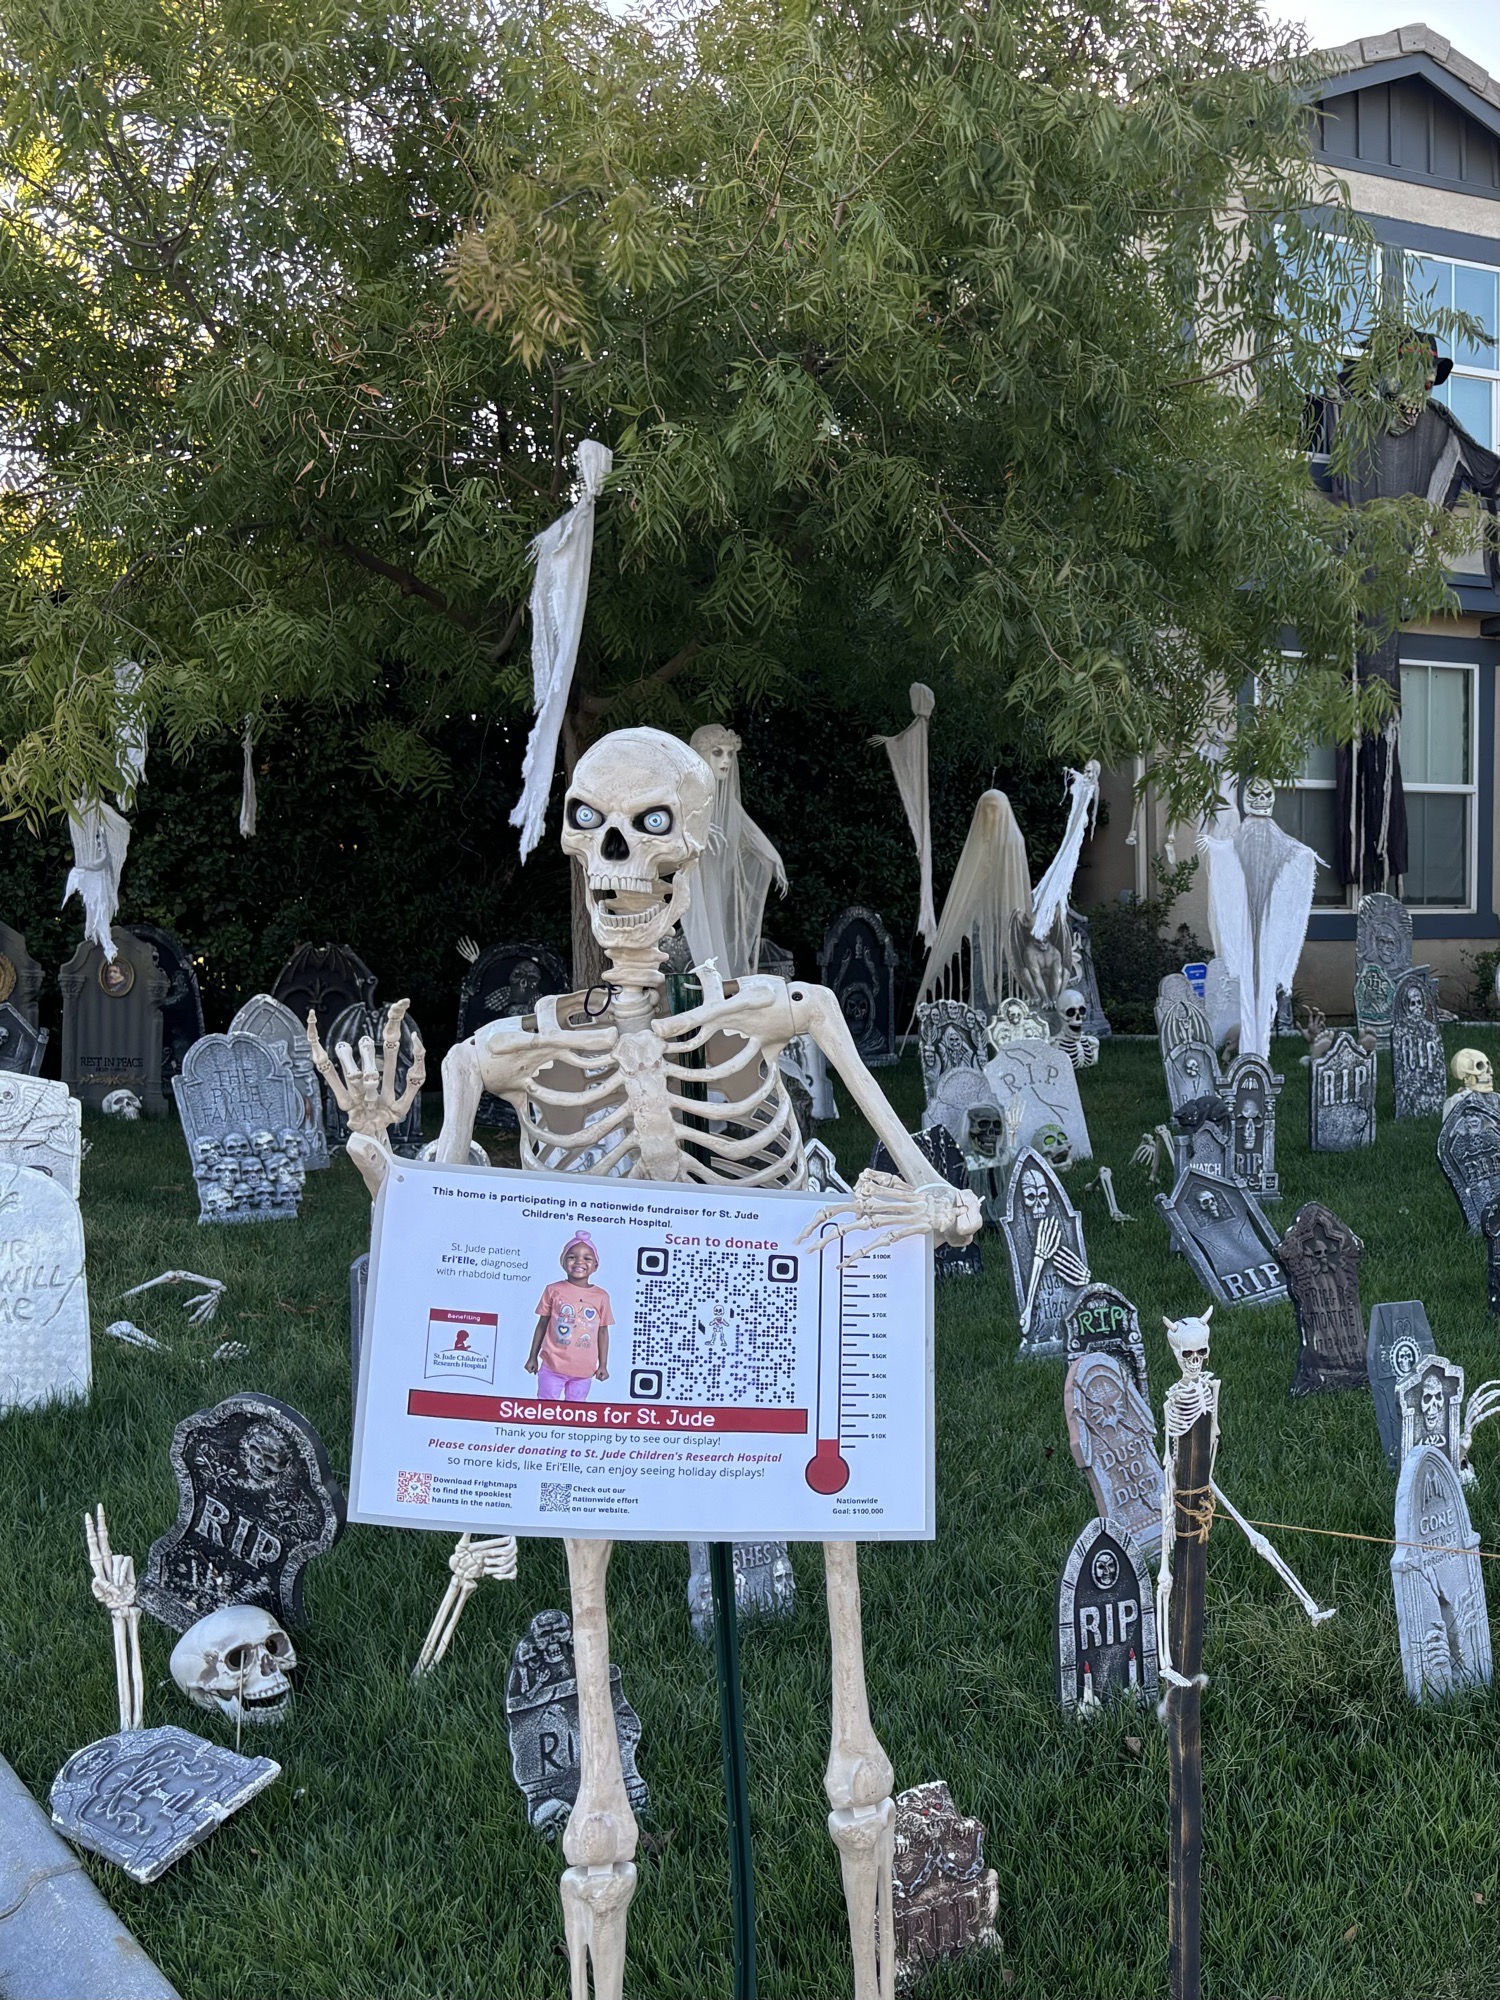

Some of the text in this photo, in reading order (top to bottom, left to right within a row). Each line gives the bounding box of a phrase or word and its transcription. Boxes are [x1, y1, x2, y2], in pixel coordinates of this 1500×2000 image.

[80, 1056, 144, 1068] REST IN PEACE
[213, 1068, 252, 1087] THE
[201, 1102, 273, 1124] FAMILY
[1236, 1153, 1262, 1175] RIP
[432, 1186, 454, 1197] This
[457, 1189, 486, 1200] home
[489, 1191, 498, 1200] is
[500, 1194, 566, 1208] participating
[568, 1198, 578, 1208] in
[590, 1201, 644, 1212] nationwide
[647, 1204, 700, 1216] fundraiser
[702, 1208, 716, 1218] for
[719, 1210, 732, 1218] St.
[734, 1210, 759, 1220] Jude
[522, 1208, 673, 1228] Children's Research Hospital.
[451, 1242, 521, 1257] St. Jude patient
[665, 1233, 779, 1251] Scan to donate
[442, 1254, 529, 1270] Eri'Elle, diagnosed
[436, 1268, 532, 1282] with rhabdoid tumor
[1221, 1262, 1281, 1300] RIP
[448, 1313, 481, 1322] Benefiting
[1078, 1305, 1126, 1336] RIP
[433, 1360, 487, 1370] Research Hospital
[500, 1400, 716, 1427] Skeletons for St. Jude
[494, 1426, 721, 1447] Thank you for stopping by to see our display!
[428, 1438, 782, 1465] Please consider donating to St. Jude Children's Research Hospital
[1100, 1437, 1147, 1471] DUST
[448, 1456, 765, 1480] so more kids, like Eri'Elle, can enjoy seeing holiday displays!
[1118, 1460, 1144, 1482] TO
[433, 1476, 518, 1489] Download Frightmaps
[442, 1486, 458, 1494] find
[460, 1488, 472, 1496] the
[474, 1490, 512, 1498] spookiest
[1115, 1474, 1157, 1507] DUST
[432, 1496, 459, 1504] haunts
[572, 1496, 616, 1504] nationwide
[598, 1506, 630, 1514] website.
[195, 1493, 282, 1569] RIP
[1420, 1509, 1455, 1535] GONE
[733, 1544, 772, 1571] SHES
[1079, 1599, 1139, 1651] RIP
[540, 1731, 575, 1776] RI
